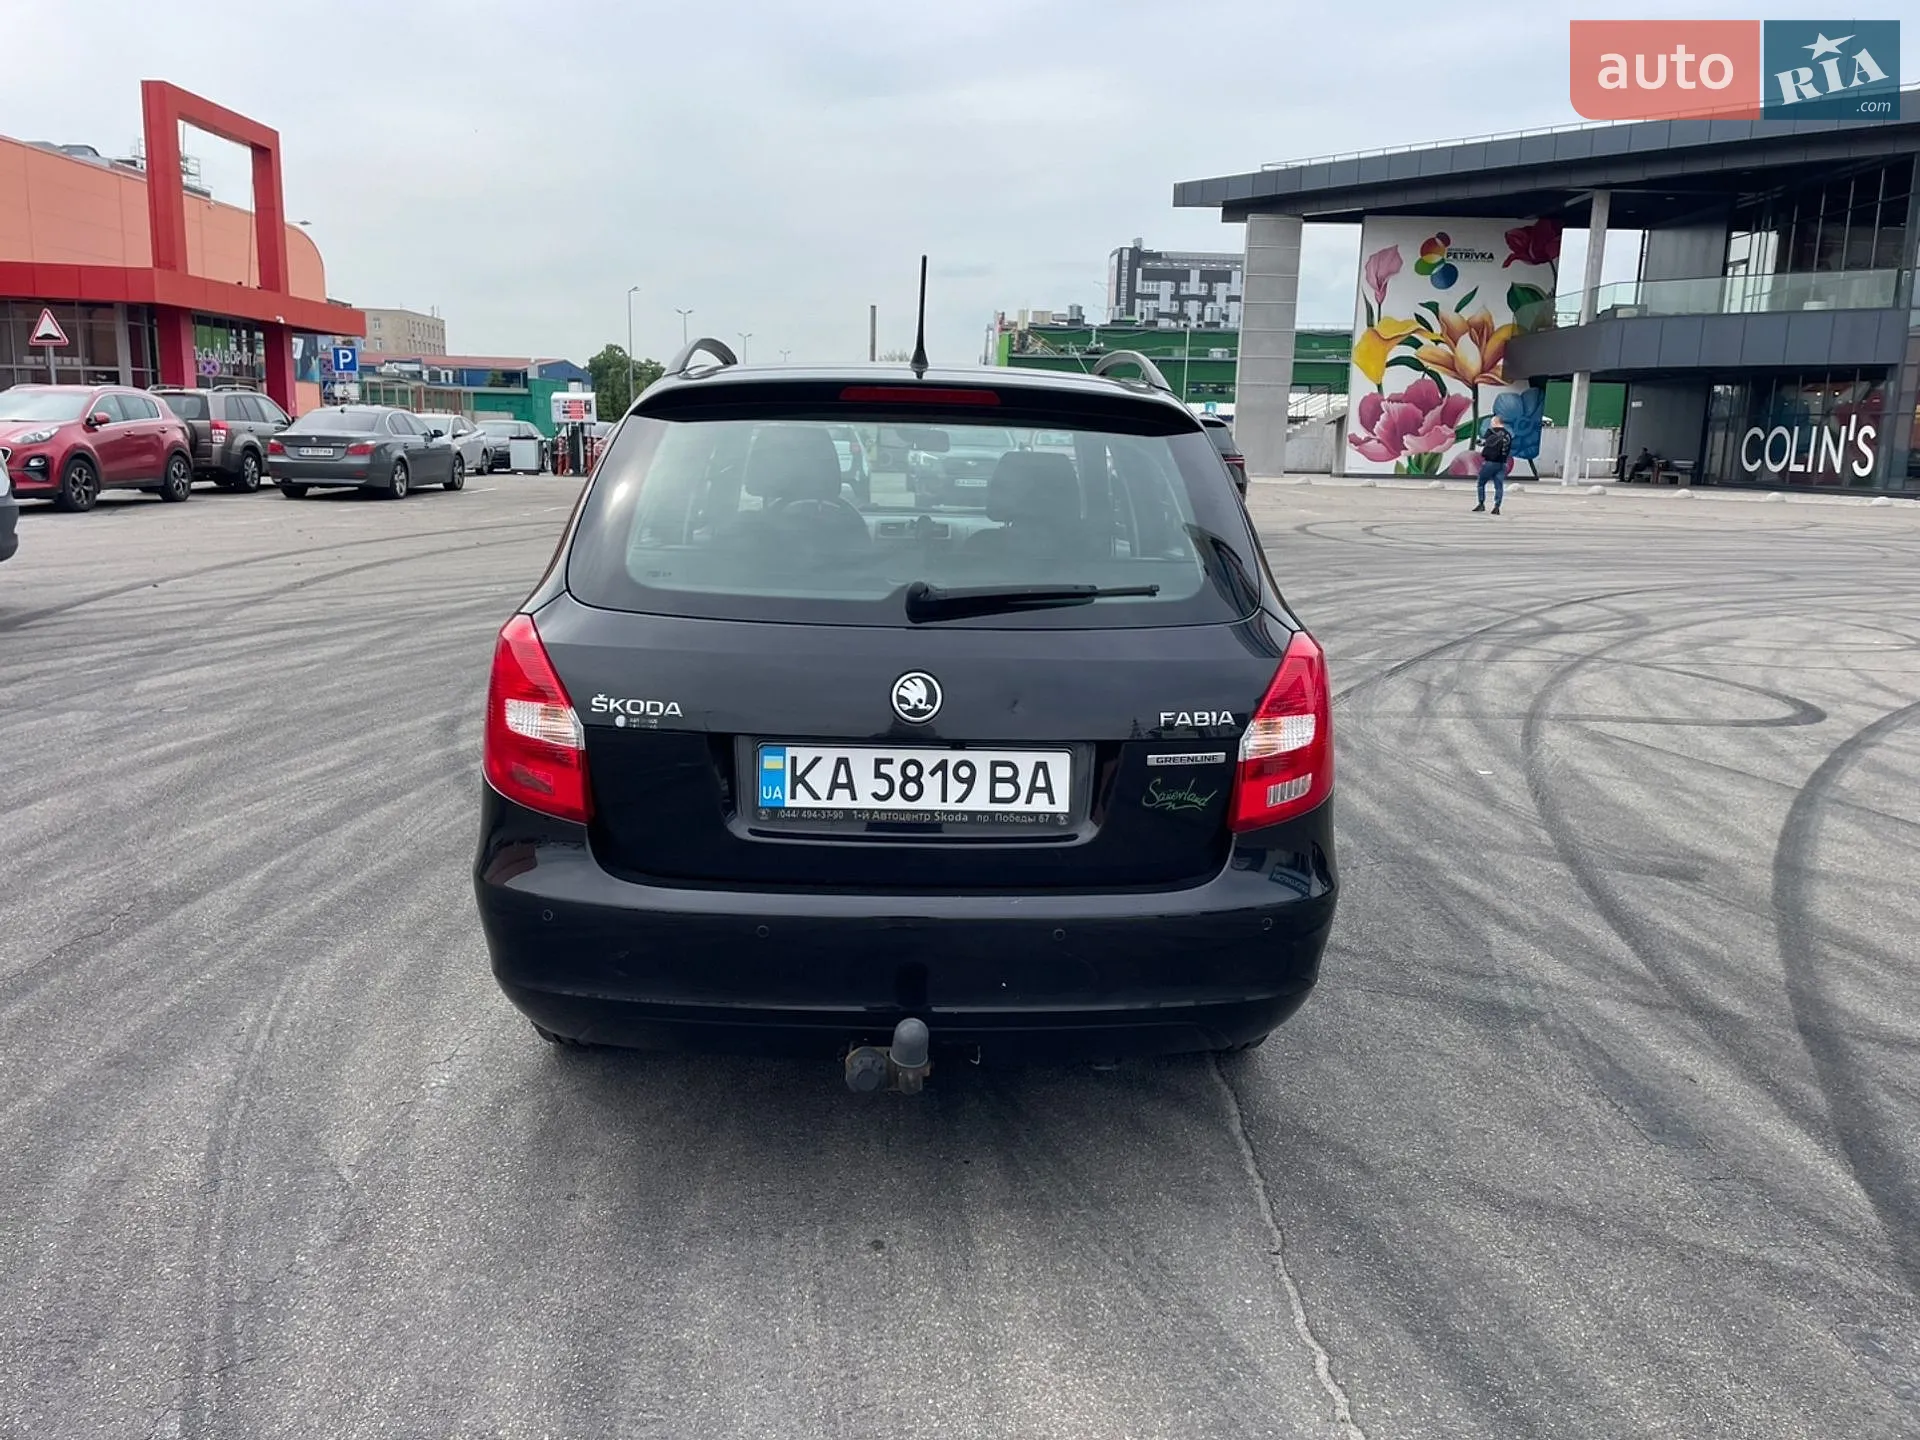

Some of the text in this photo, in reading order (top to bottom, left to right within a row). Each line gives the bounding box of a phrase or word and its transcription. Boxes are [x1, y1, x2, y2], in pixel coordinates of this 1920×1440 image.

[1446, 251, 1494, 260] PETRIVKA
[1741, 414, 1877, 478] COLIN'S
[590, 693, 683, 717] ŠKODA
[1160, 711, 1236, 727] FABIA
[1155, 754, 1218, 764] GREENLINE
[789, 755, 1056, 805] KA 5819 BA
[762, 786, 783, 800] UA
[872, 810, 931, 822] Автоцентр
[995, 812, 1036, 824] Победы
